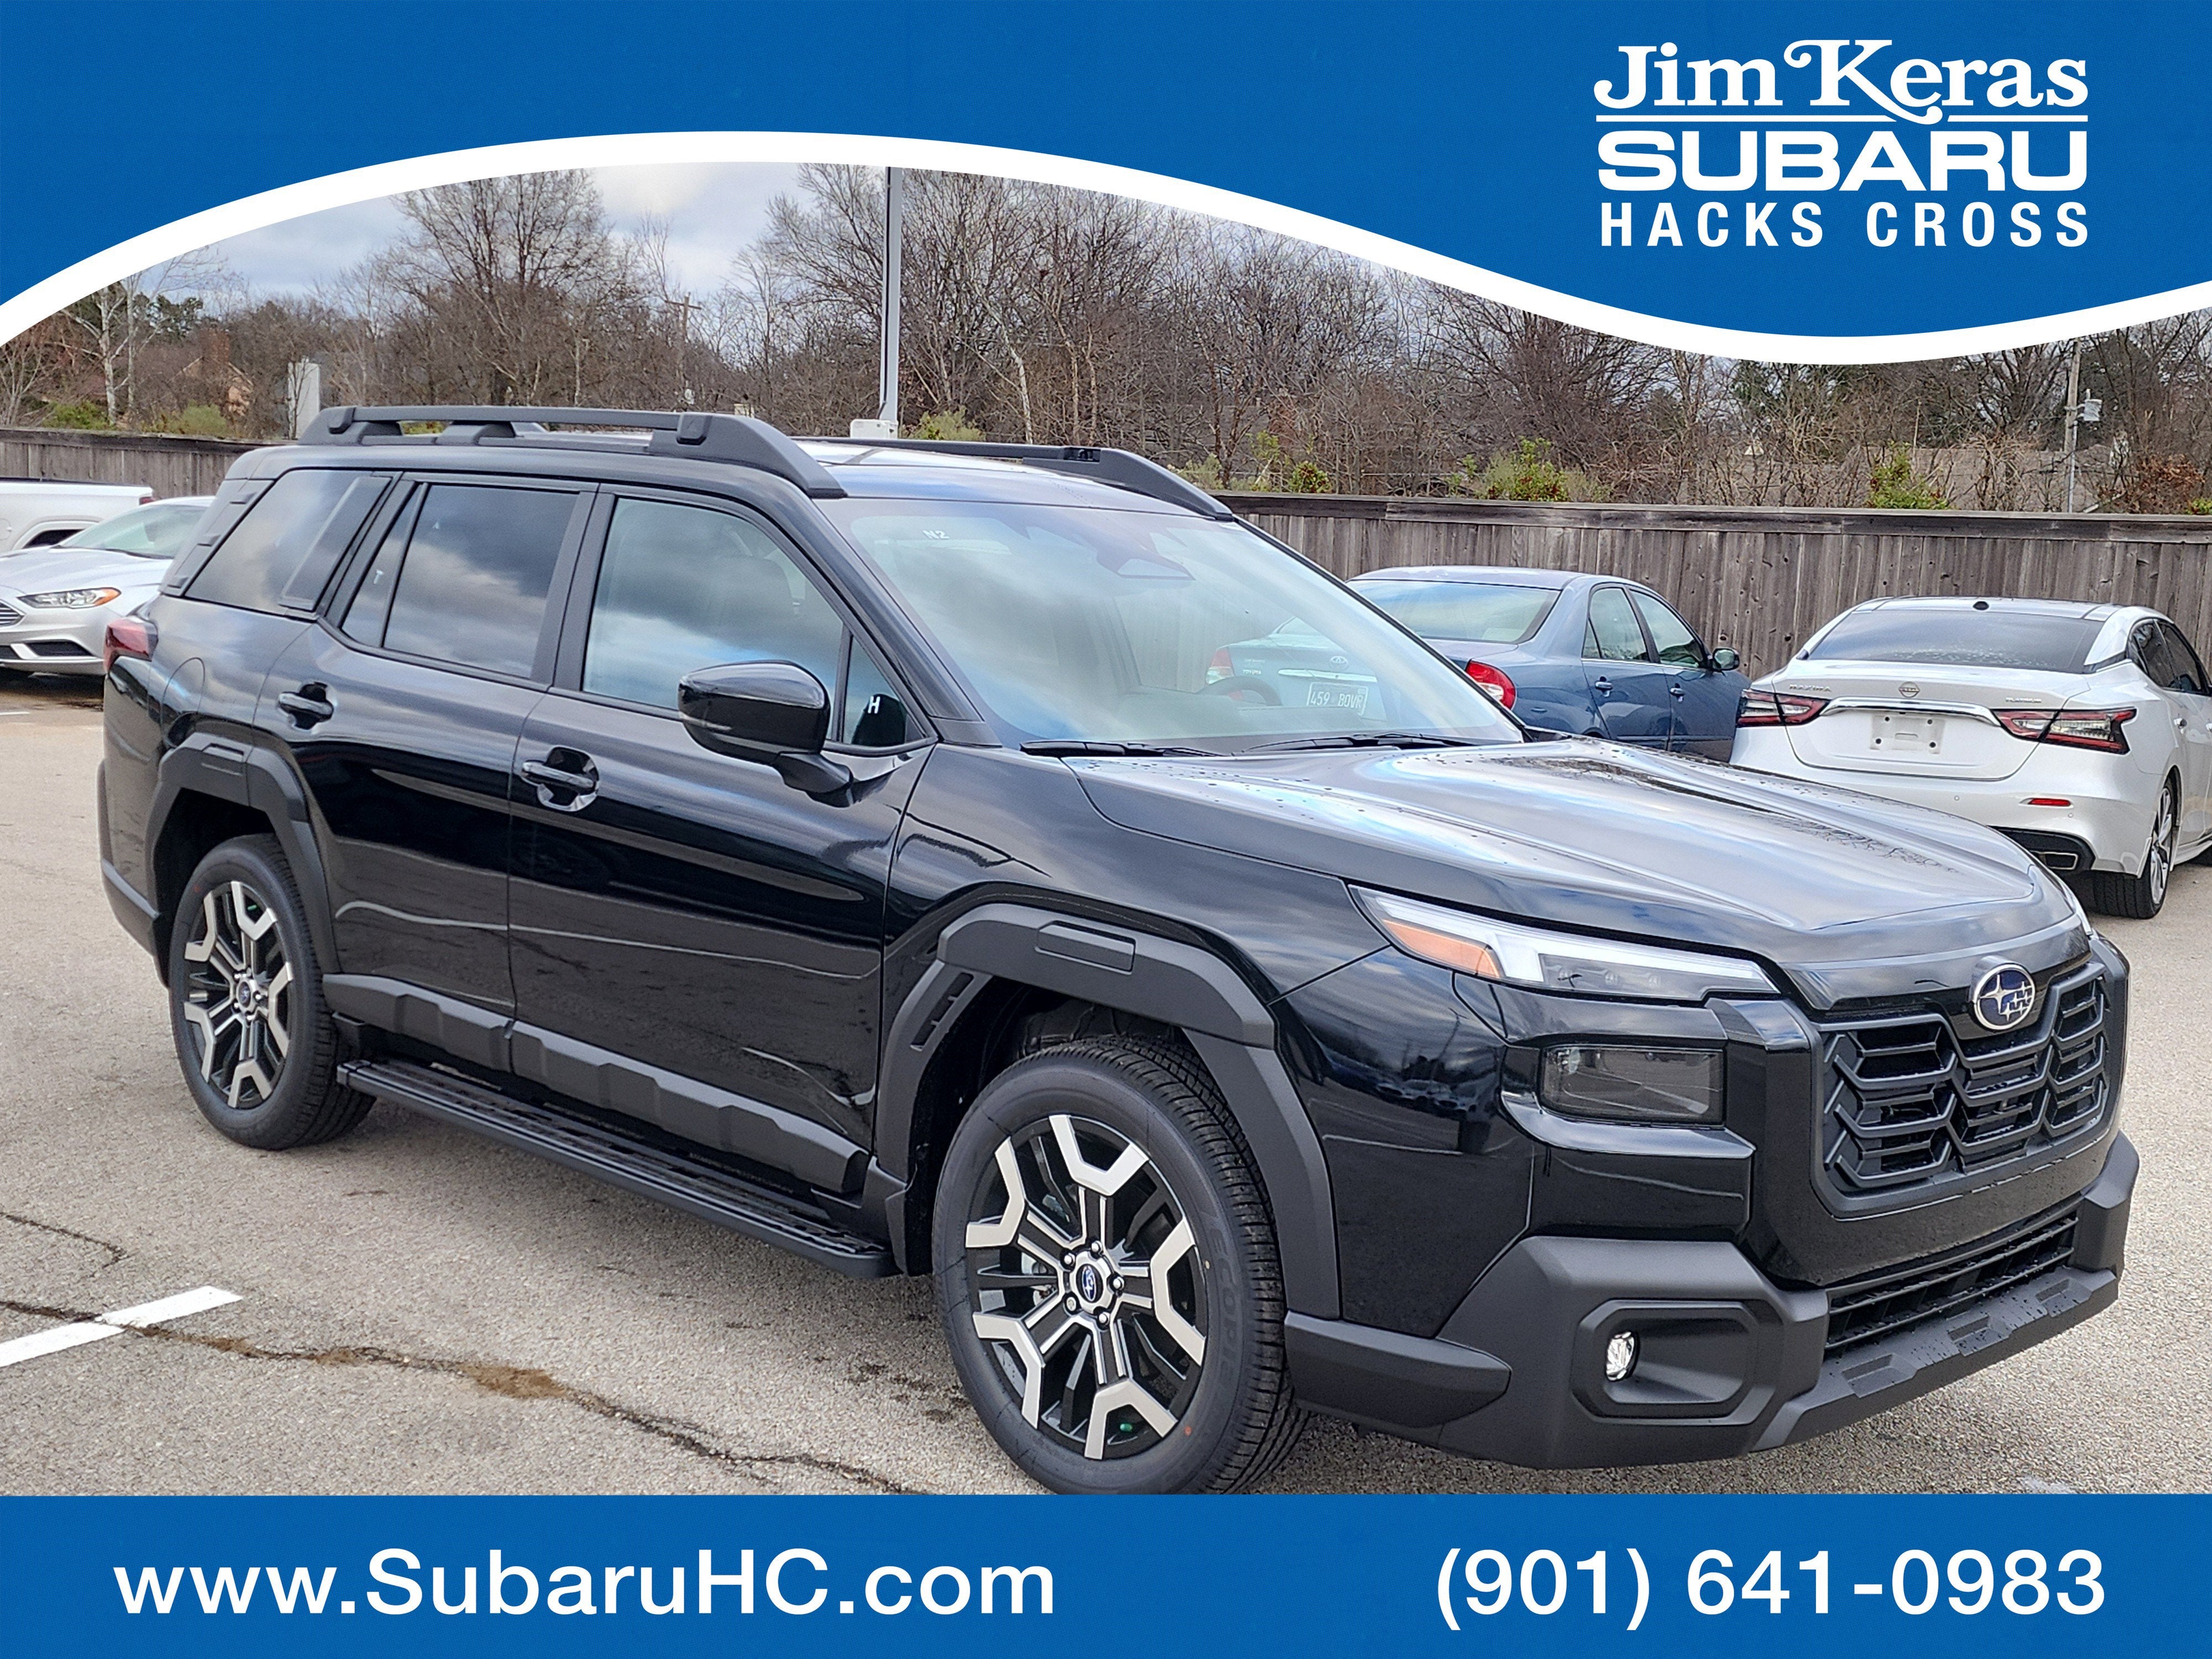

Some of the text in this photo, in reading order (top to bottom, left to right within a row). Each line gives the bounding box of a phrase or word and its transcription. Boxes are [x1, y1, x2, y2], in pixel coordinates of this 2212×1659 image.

[922, 530, 950, 539] N2
[868, 696, 880, 713] H
[1310, 691, 1330, 706] 459
